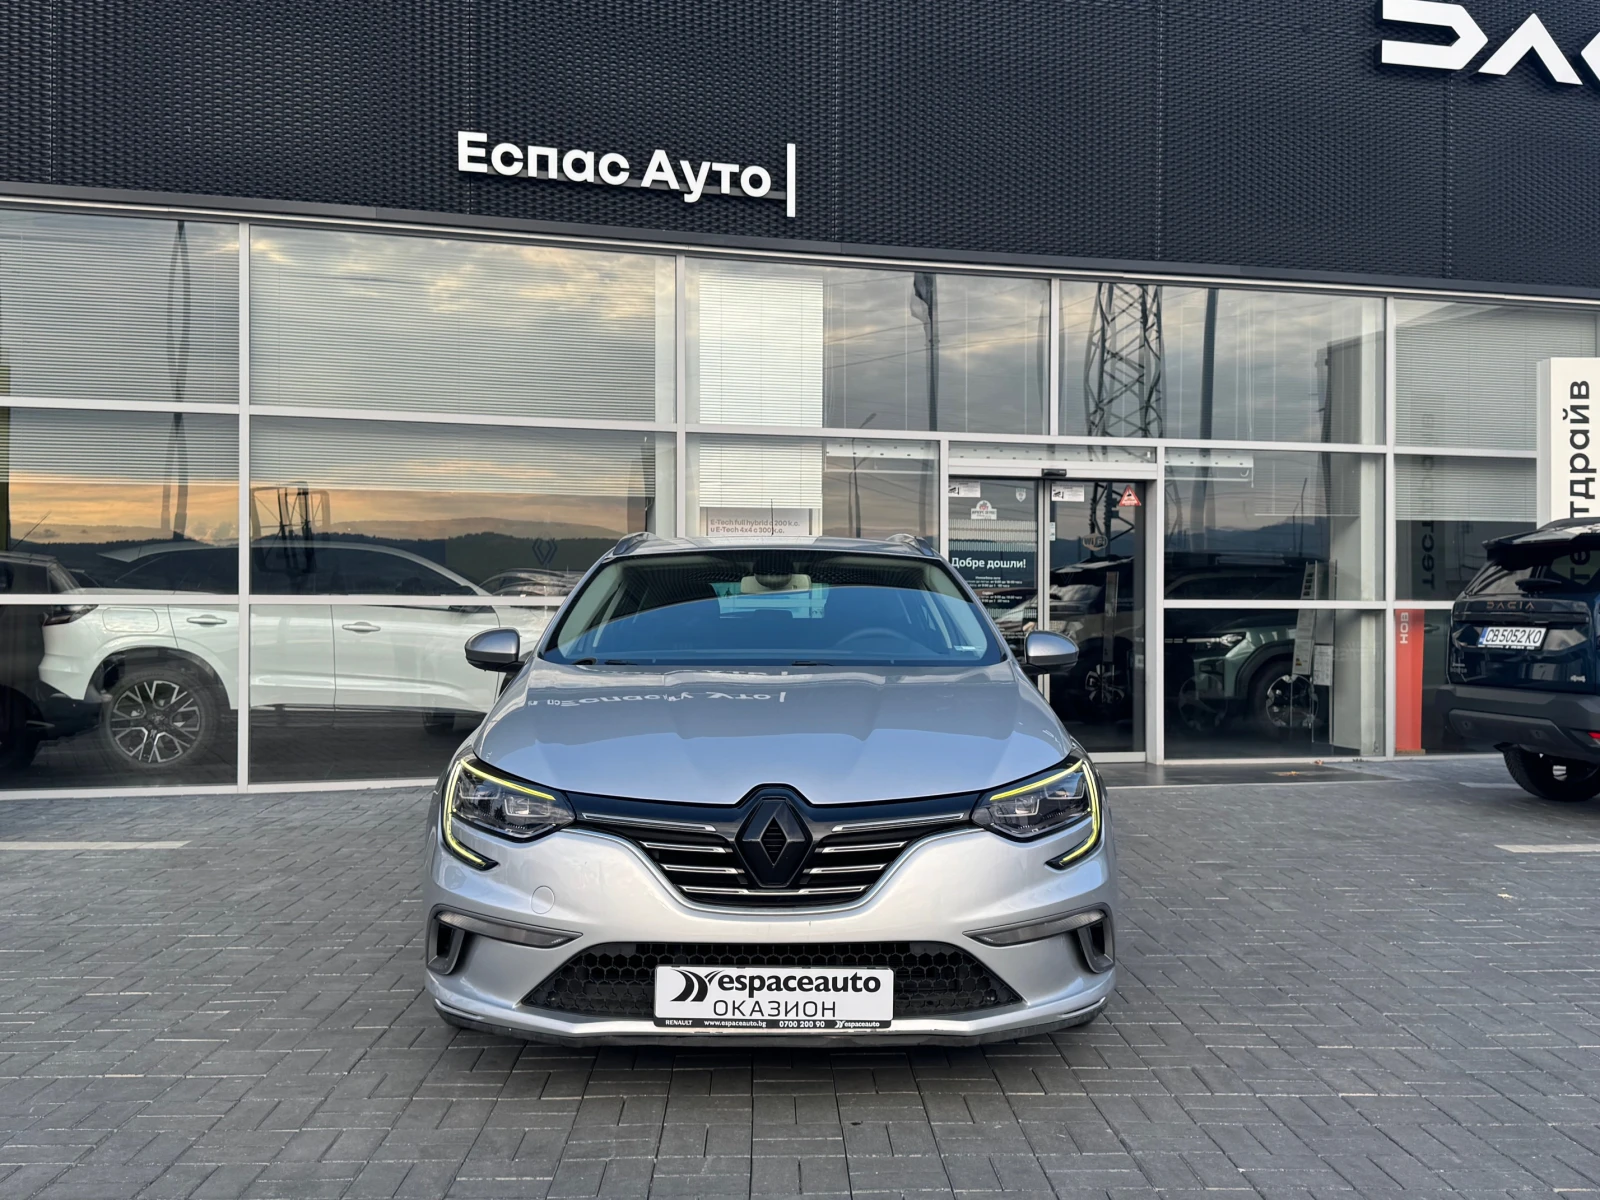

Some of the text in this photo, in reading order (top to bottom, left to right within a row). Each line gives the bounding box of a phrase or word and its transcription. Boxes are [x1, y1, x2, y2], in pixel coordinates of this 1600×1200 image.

[1381, 0, 1600, 86] DA
[457, 130, 772, 203] Еспас Ауто
[746, 519, 768, 527] hybrid
[951, 557, 1027, 570] Добре дошли!
[1486, 601, 1535, 610] DACIA
[717, 971, 881, 999] espaceauto
[713, 1000, 836, 1017] ОКАЗИОН
[703, 1020, 767, 1028] www.espaceauto.bg
[844, 1021, 880, 1029] espaceauto
